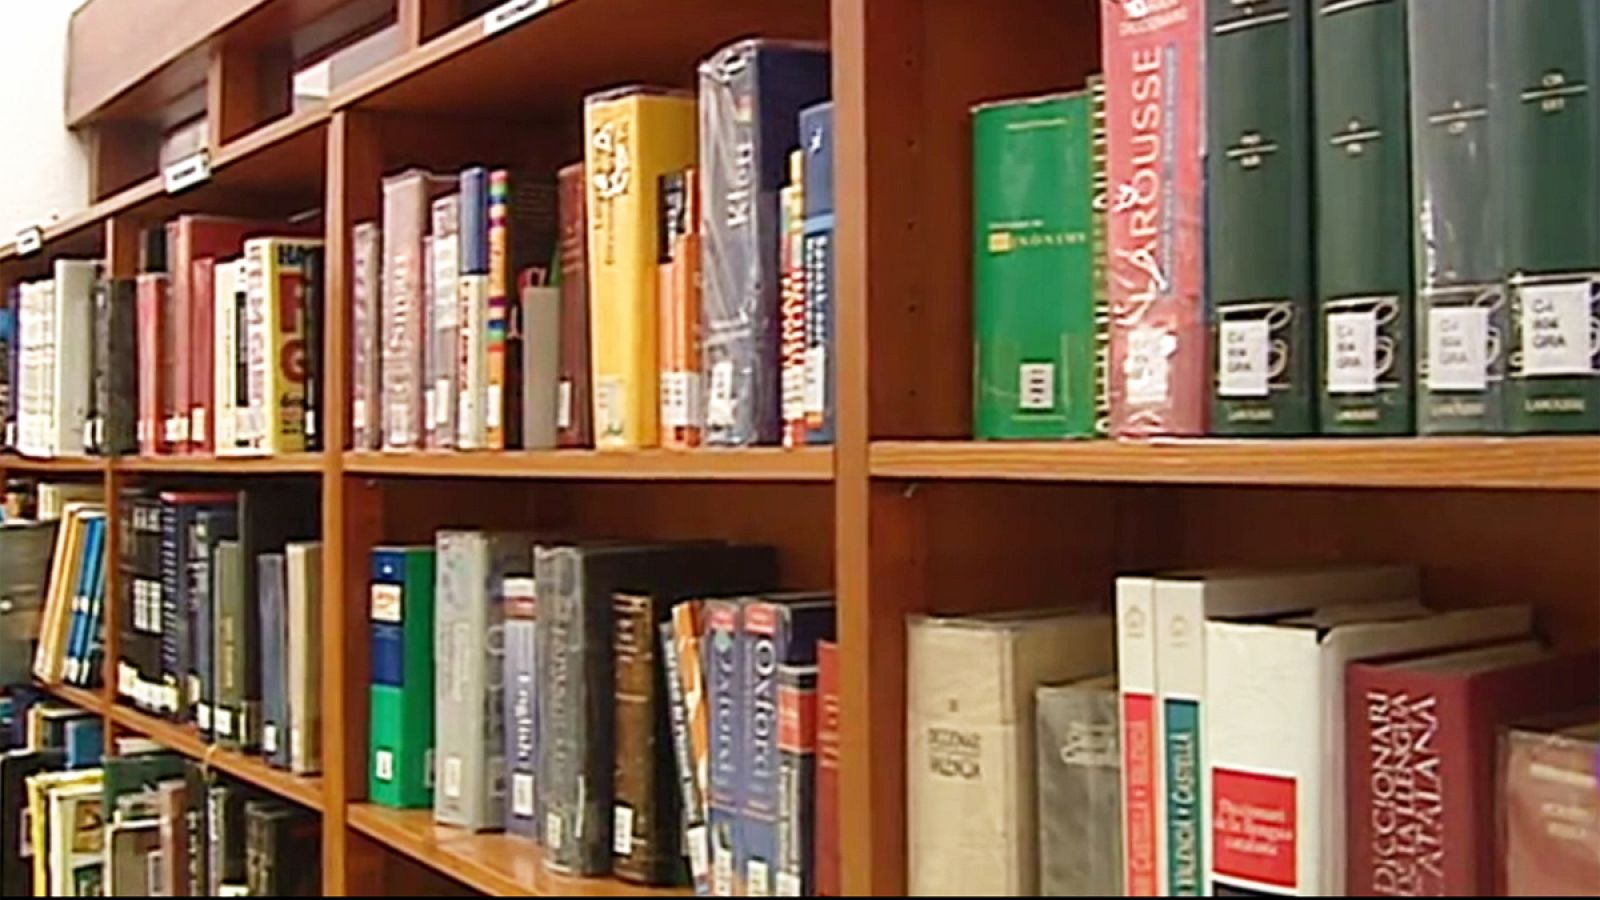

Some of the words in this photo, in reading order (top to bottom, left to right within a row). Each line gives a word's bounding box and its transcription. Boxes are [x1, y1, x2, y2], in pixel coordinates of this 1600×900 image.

[1129, 46, 1162, 308] LAROUSSE
[752, 639, 776, 778] Oxford
[1367, 691, 1396, 894] DICCIONARI
